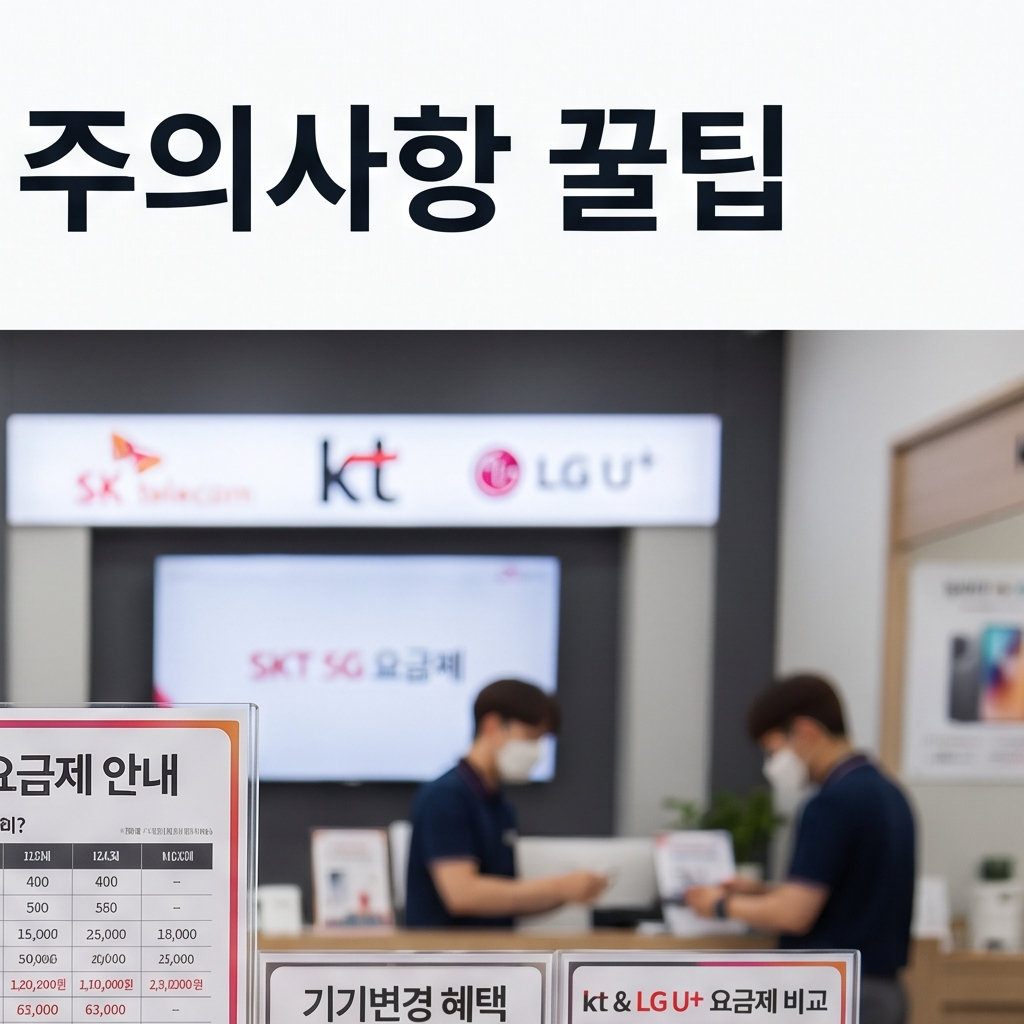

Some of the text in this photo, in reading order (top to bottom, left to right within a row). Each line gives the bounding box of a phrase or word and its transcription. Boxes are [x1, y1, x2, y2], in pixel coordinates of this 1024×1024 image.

[320, 436, 399, 504] kt
[249, 650, 311, 683] SKT
[102, 753, 178, 797] 안내
[26, 875, 50, 888] 400
[94, 875, 118, 888] 400
[26, 901, 49, 914] 500
[17, 928, 58, 942] 15,000
[86, 928, 127, 942] 25,000
[157, 928, 197, 943] 18,000
[158, 953, 195, 967] 25,000
[85, 1003, 126, 1018] 63,000
[302, 984, 507, 1023] 기기변경 혜택
[582, 987, 828, 1015] kt & LG U+ 요금제 비교
